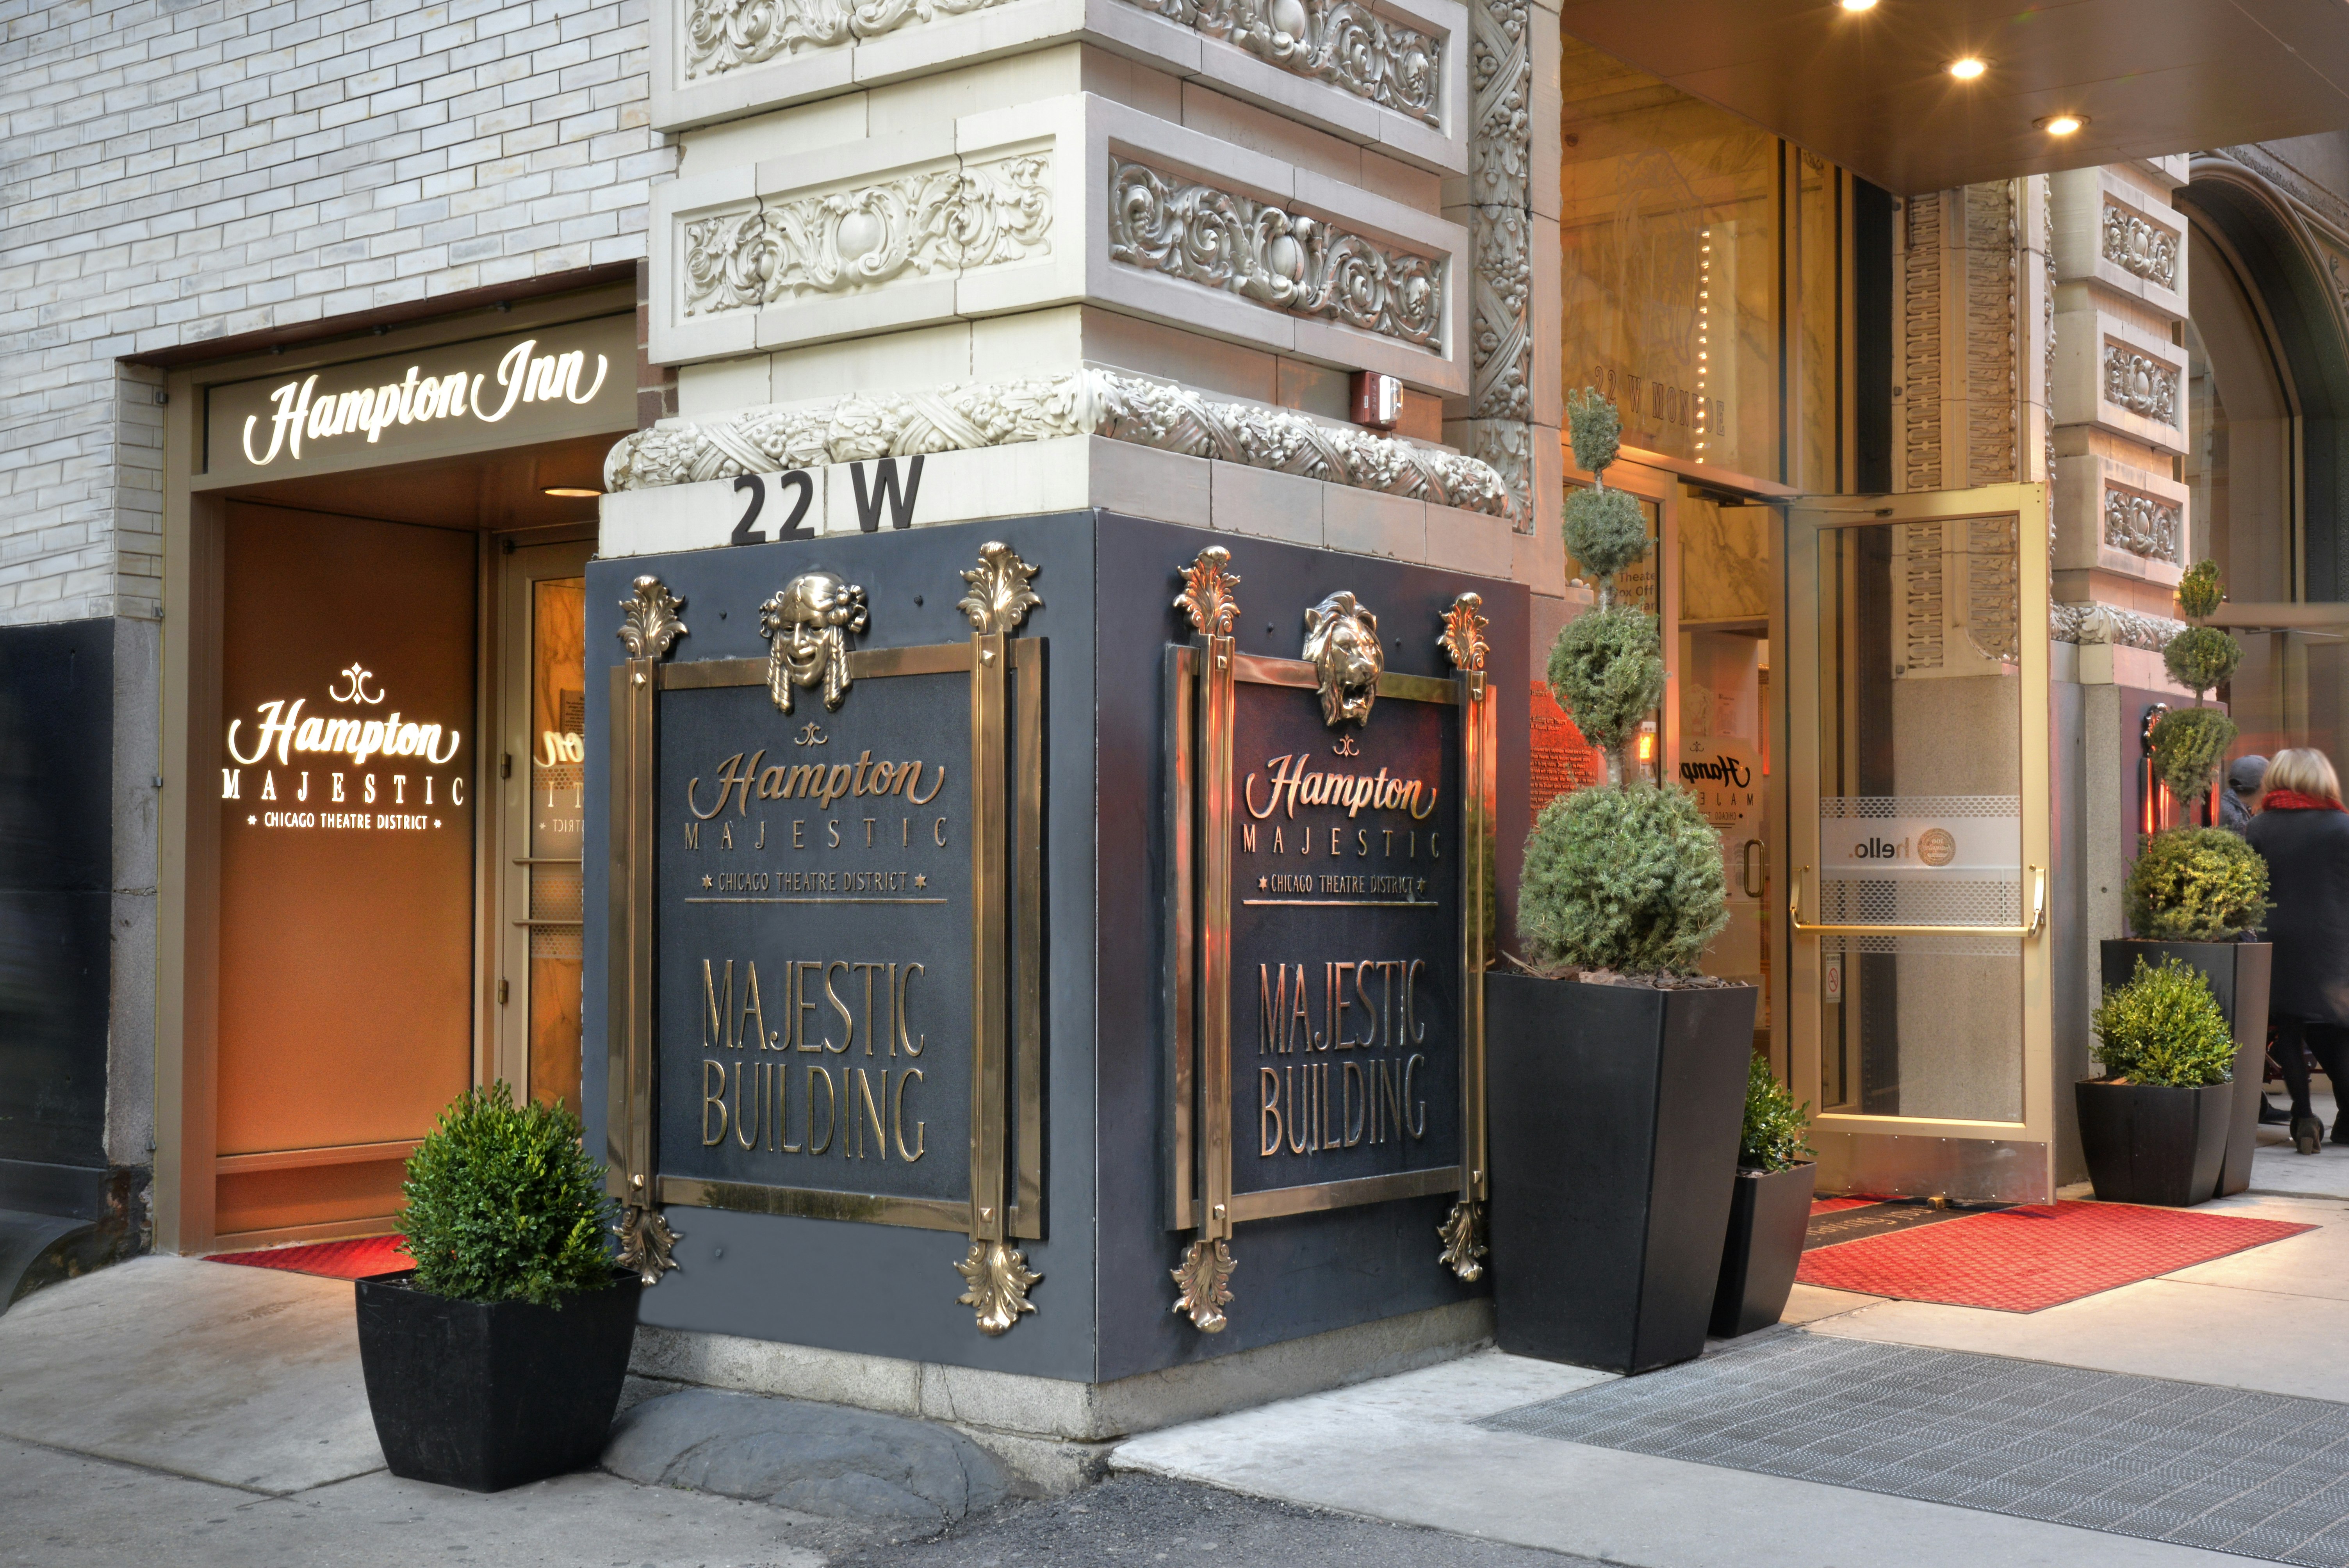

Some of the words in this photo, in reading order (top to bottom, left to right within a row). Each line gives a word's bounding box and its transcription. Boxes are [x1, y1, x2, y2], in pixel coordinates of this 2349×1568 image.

[243, 365, 467, 466] Hampton
[471, 339, 607, 422] Inn
[1595, 366, 1616, 406] 22
[1627, 374, 1641, 413] W
[1652, 381, 1725, 436] MONROE
[731, 470, 814, 545] 22
[850, 454, 925, 533] W
[1616, 588, 1632, 597] ox
[228, 698, 460, 765] Hampton
[221, 768, 464, 806] MAJESTIC
[688, 749, 944, 820] Hampton
[1246, 754, 1436, 820] Hampton
[264, 811, 315, 828] CHICAGO
[320, 813, 371, 829] THEATRE
[377, 814, 428, 830] DISTRICT
[684, 817, 947, 850] MAJESTIC
[1243, 823, 1440, 858] MAJESTIC
[718, 873, 769, 891] CHICAGO
[776, 872, 836, 891] THEATRE
[843, 872, 908, 891] DISTRICT
[1271, 873, 1312, 893] CHICAGO
[1319, 875, 1365, 893] THEATRE
[1370, 875, 1413, 893] DISTRICT
[703, 959, 925, 1057] MAJESTIC
[1260, 959, 1425, 1054] MAJESTIC
[703, 1060, 925, 1162] BUILDING
[1260, 1054, 1426, 1156] BUILDING
